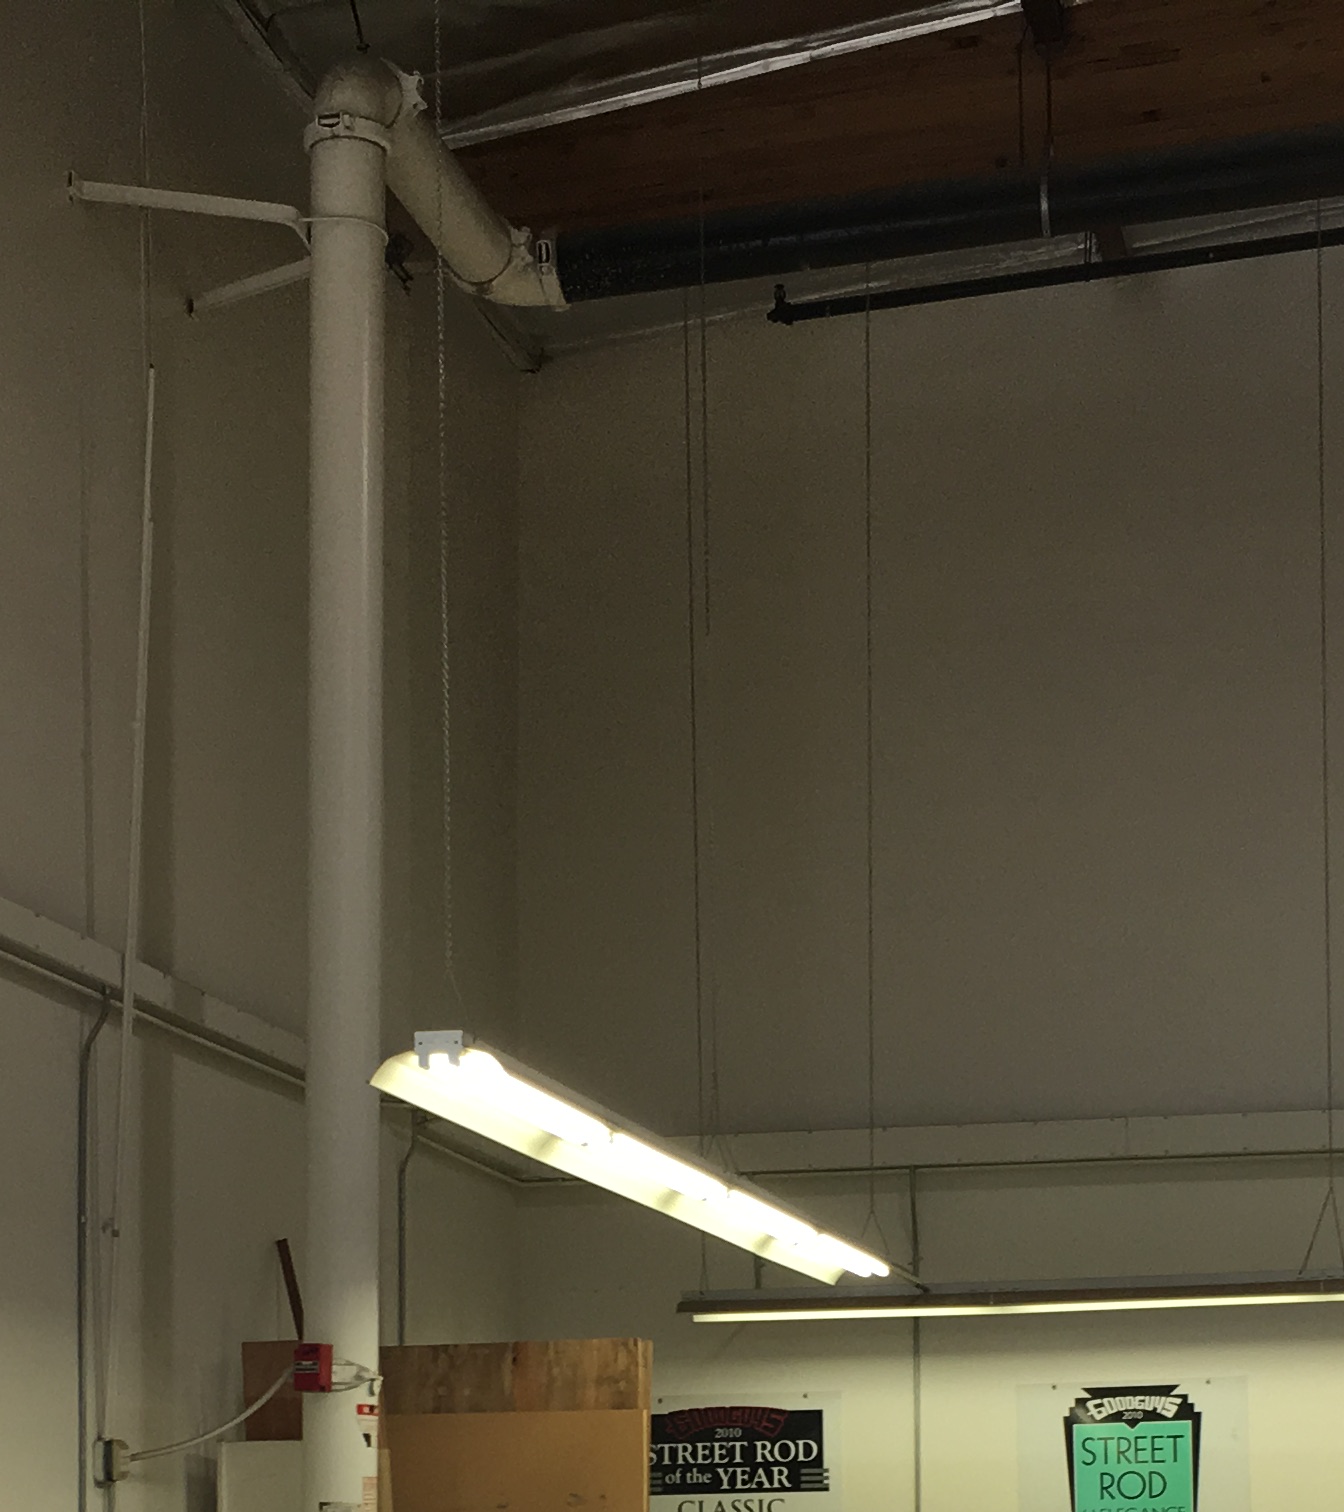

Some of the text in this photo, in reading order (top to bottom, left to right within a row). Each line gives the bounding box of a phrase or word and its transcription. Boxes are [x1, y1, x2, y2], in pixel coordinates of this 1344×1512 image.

[1086, 1396, 1184, 1420] GOODGUYS
[715, 1428, 743, 1439] 2010
[649, 1439, 819, 1466] STREET ROD
[1081, 1435, 1185, 1466] STREET
[665, 1465, 793, 1490] of the YEAR
[1099, 1470, 1168, 1500] ROD
